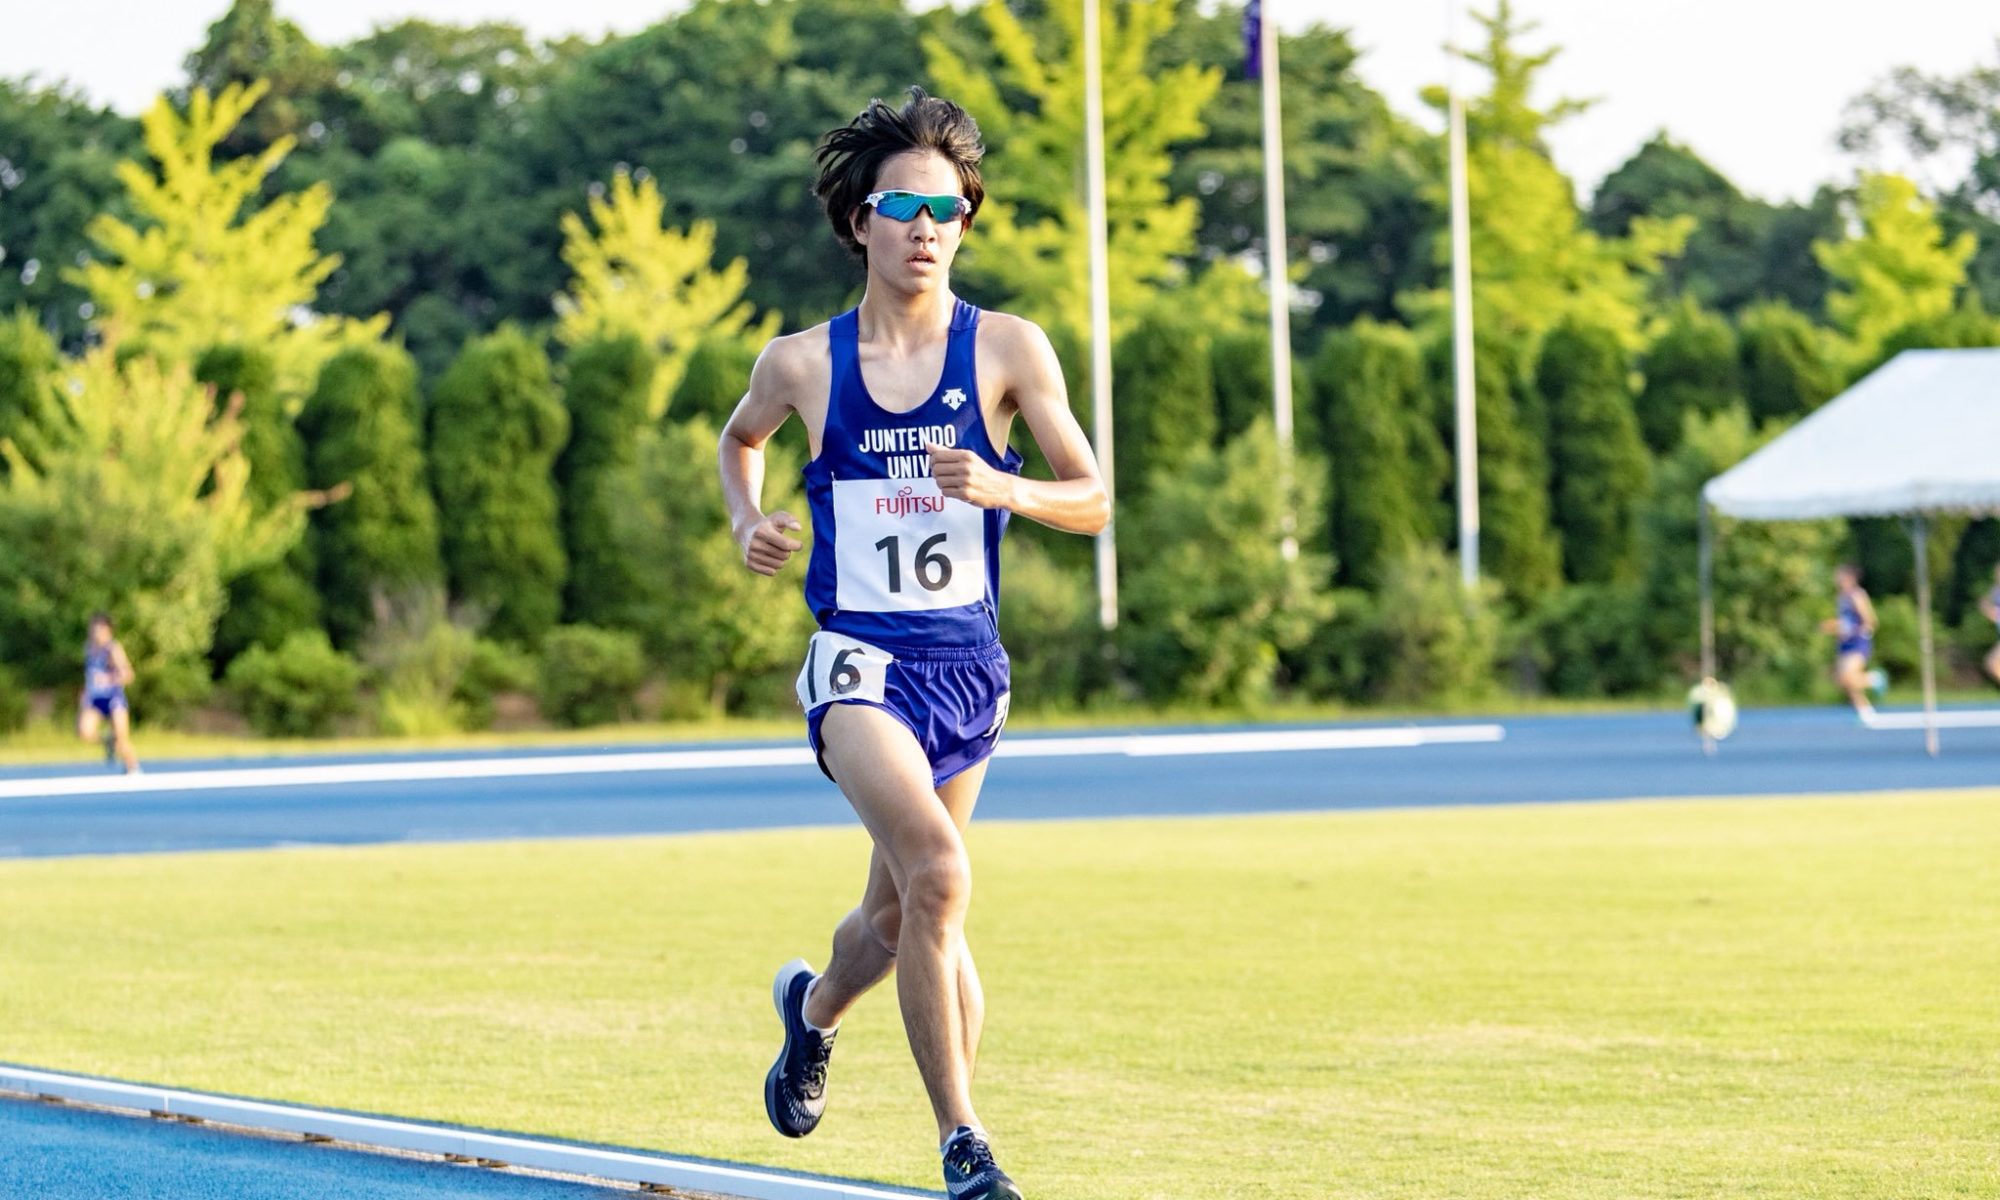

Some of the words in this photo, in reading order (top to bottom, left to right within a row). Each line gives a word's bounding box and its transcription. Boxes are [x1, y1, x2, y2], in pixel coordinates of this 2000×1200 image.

[858, 424, 956, 453] JUNTENDO
[886, 454, 931, 479] UNIV
[875, 487, 945, 519] FUJITSU
[875, 532, 953, 593] 16
[807, 639, 866, 703] 16
